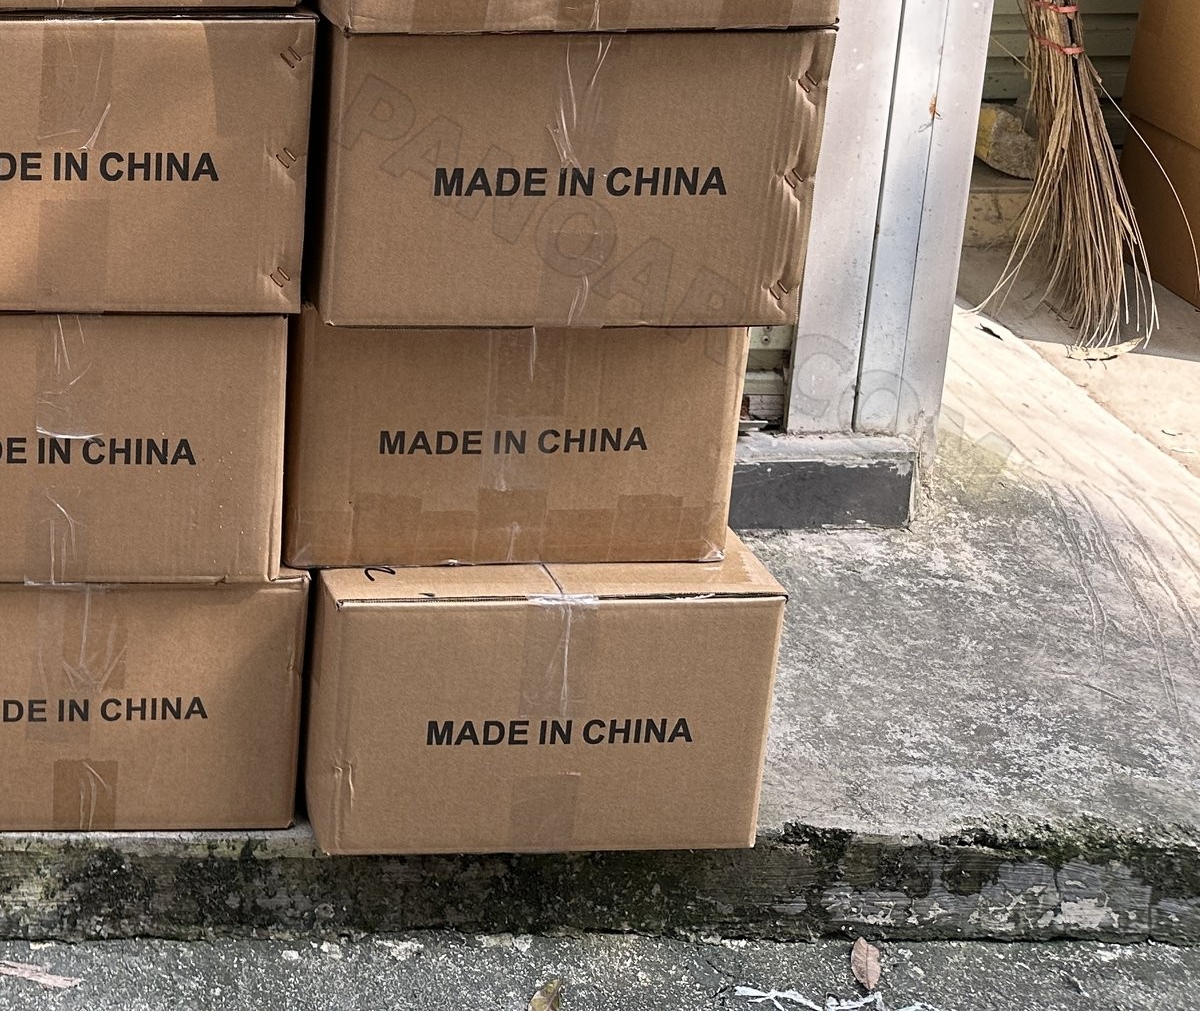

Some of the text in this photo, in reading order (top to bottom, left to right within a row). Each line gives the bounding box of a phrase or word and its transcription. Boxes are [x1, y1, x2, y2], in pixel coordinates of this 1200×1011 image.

[54, 153, 87, 181] IN
[100, 152, 219, 181] CHINA
[434, 167, 726, 196] MADE IN CHINA
[38, 438, 71, 464] IN
[83, 438, 196, 465] CHINA
[380, 427, 647, 454] MADE IN CHINA
[58, 699, 89, 722] IN
[101, 697, 208, 721] CHINA
[427, 718, 692, 745] MADE IN CHINA
